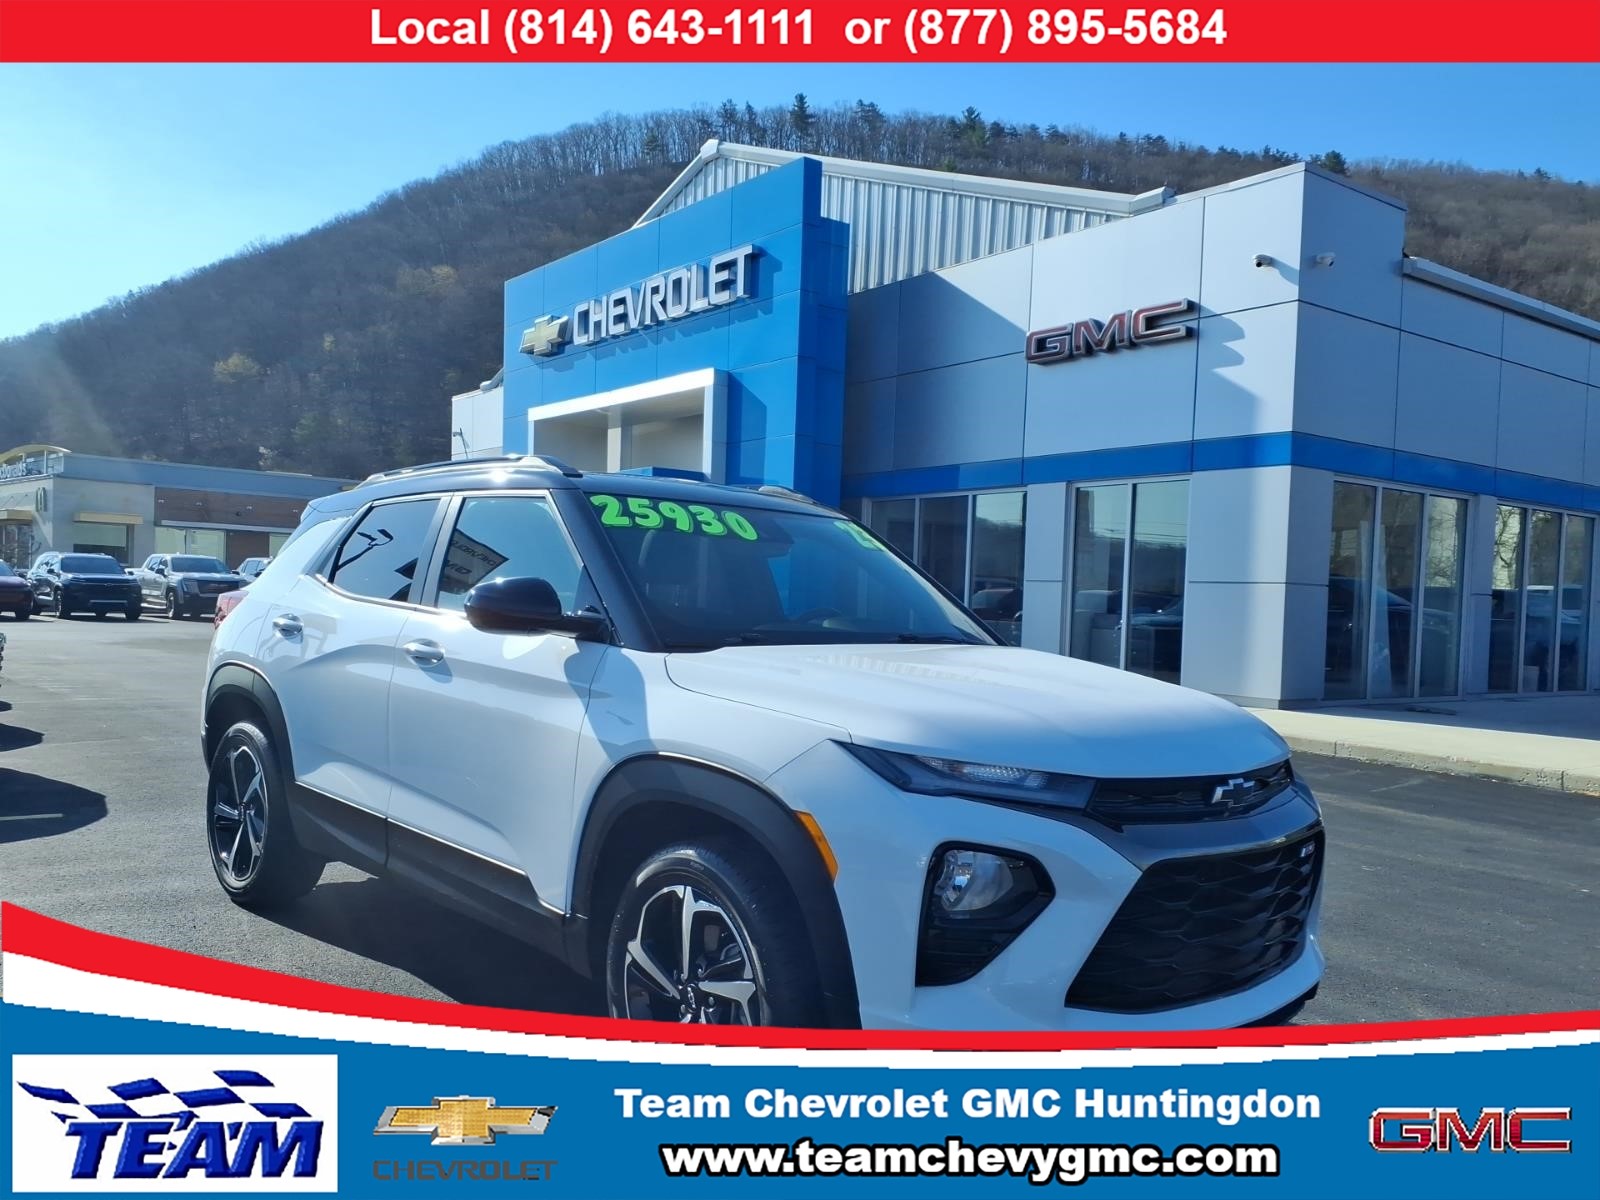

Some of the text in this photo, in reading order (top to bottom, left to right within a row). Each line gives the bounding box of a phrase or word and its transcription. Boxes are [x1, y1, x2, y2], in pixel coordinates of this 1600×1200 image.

[572, 244, 756, 346] CHEVROLET
[1025, 297, 1195, 364] GMC
[589, 494, 759, 541] 25930
